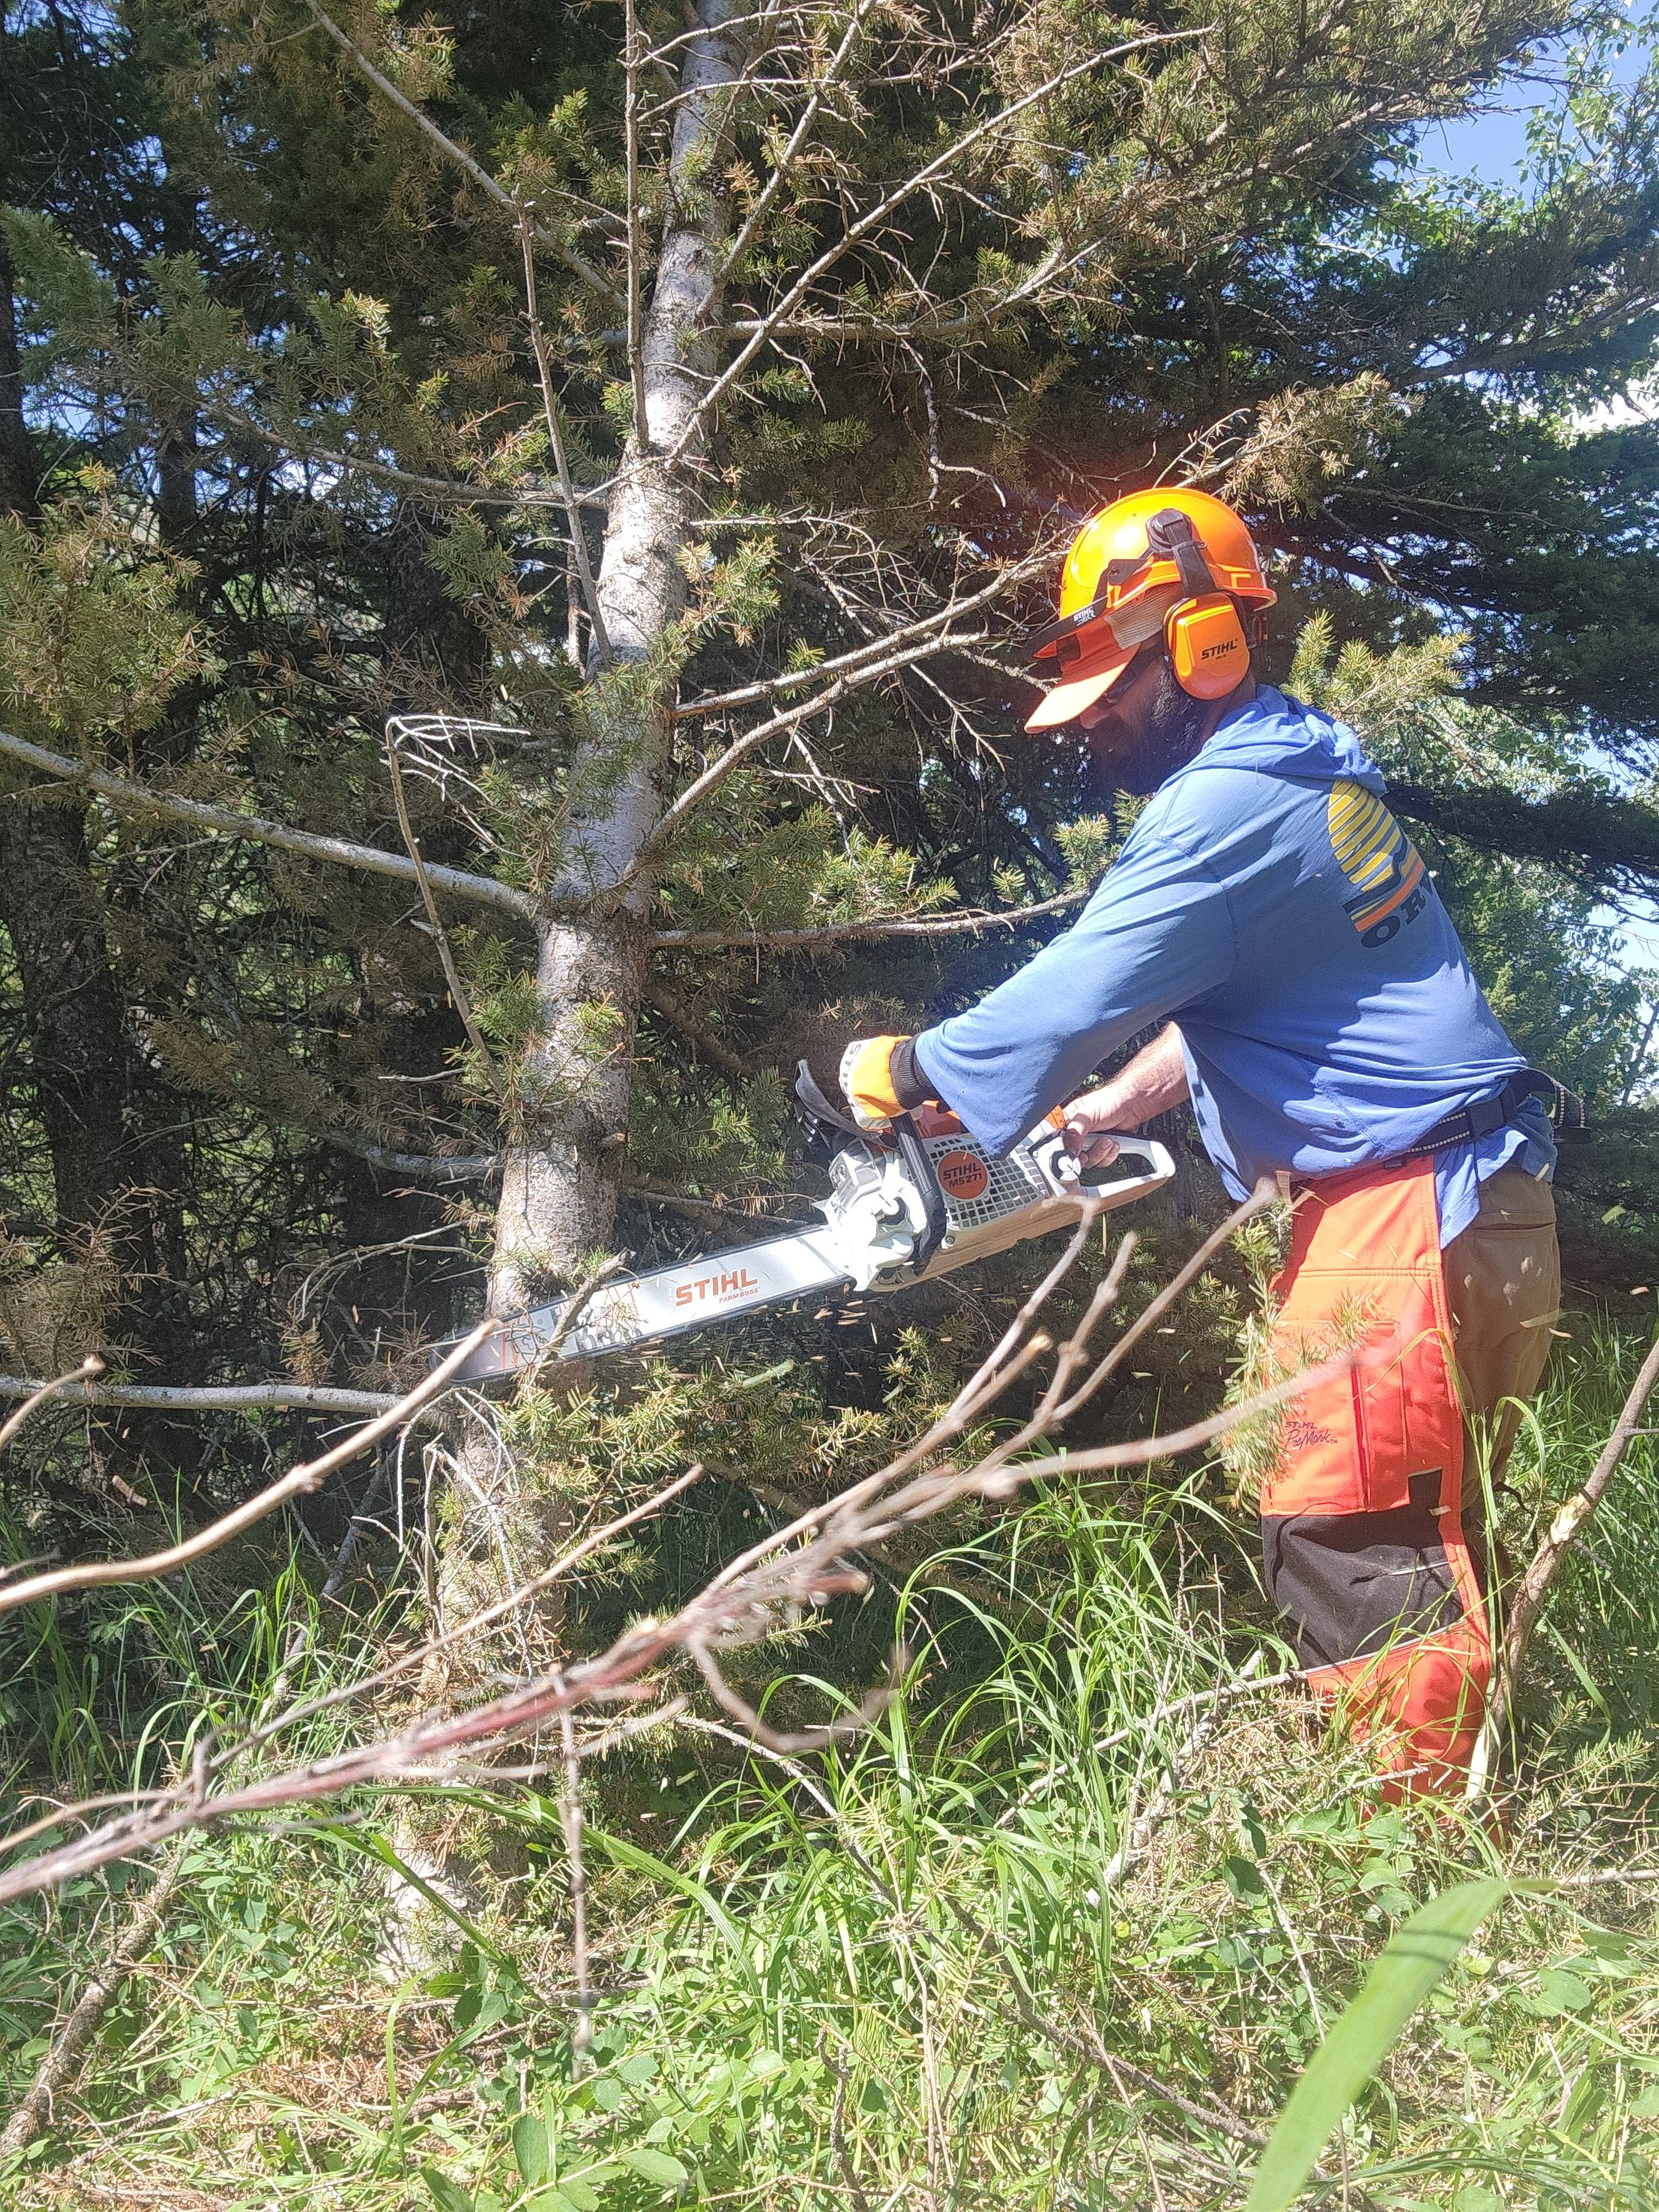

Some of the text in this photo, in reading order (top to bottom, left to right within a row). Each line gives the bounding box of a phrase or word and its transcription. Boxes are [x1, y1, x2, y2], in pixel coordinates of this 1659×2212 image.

[1201, 639, 1237, 660] STIHL
[943, 1162, 982, 1180] STIHL
[676, 1268, 758, 1307] STIHL
